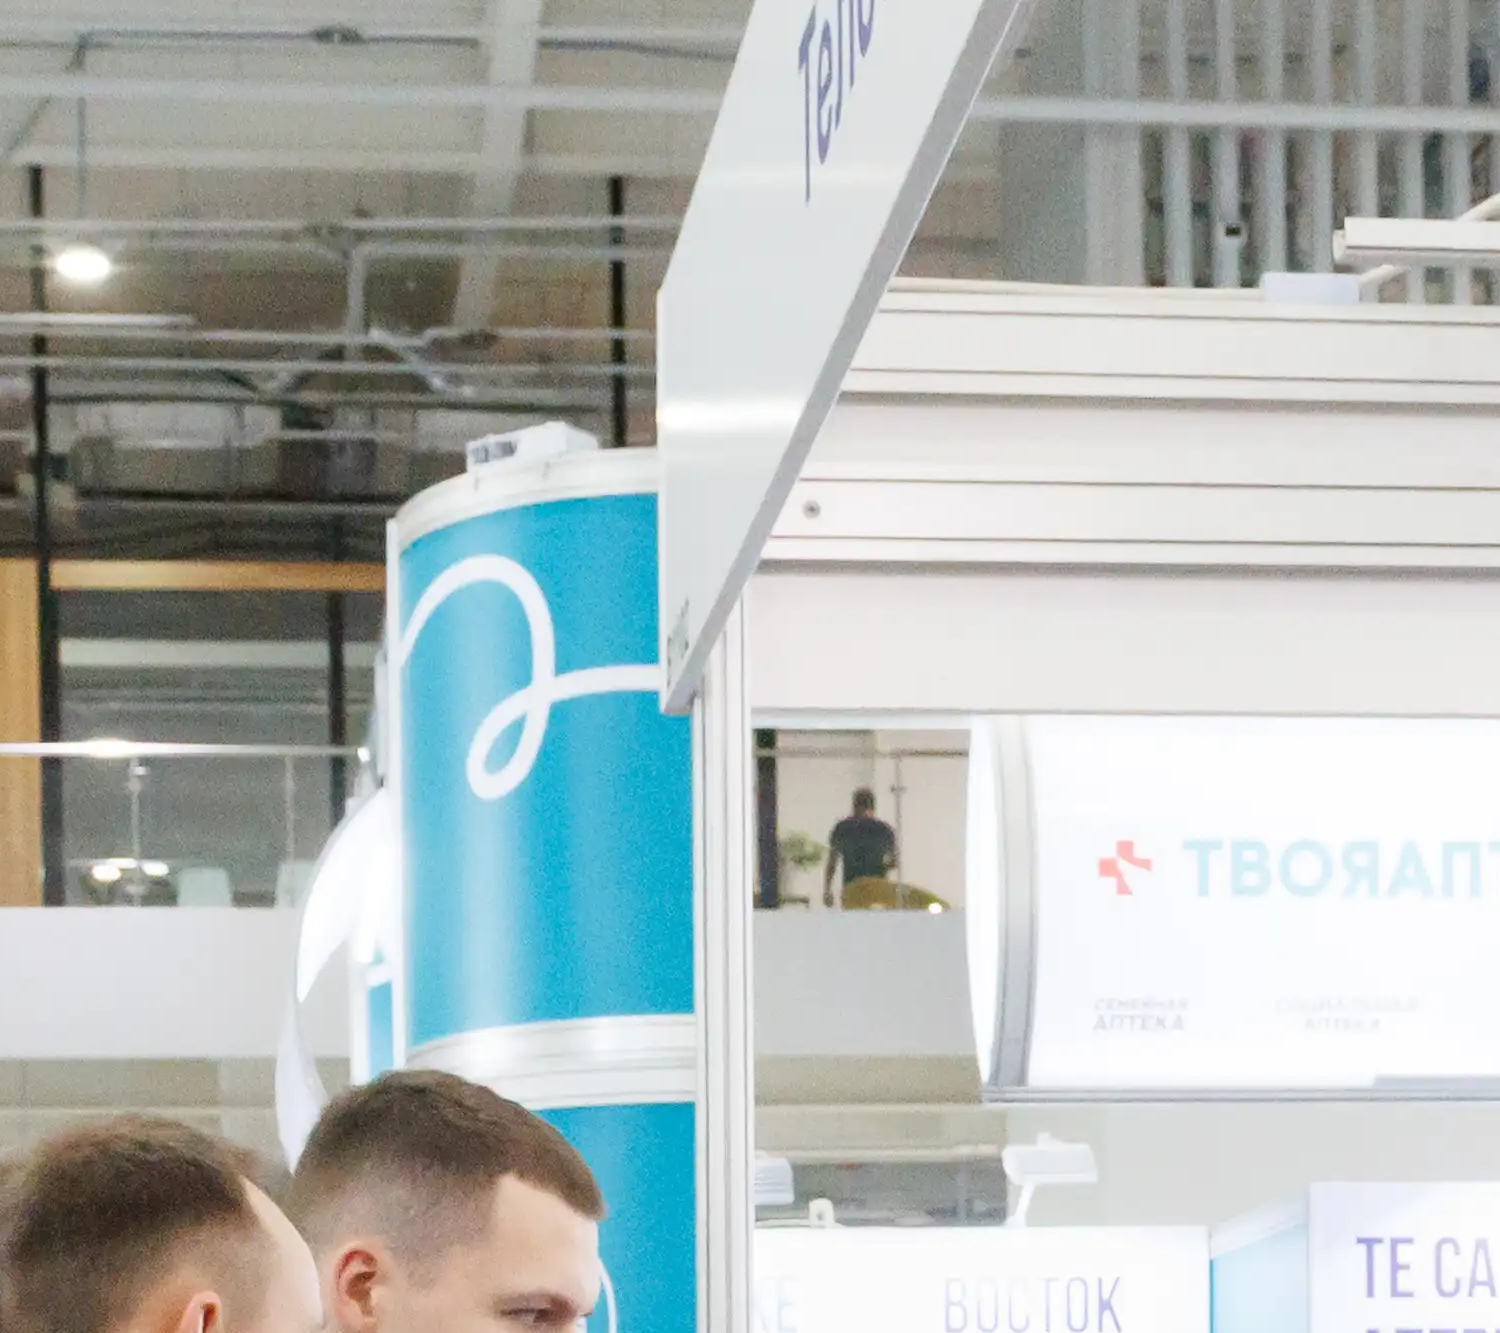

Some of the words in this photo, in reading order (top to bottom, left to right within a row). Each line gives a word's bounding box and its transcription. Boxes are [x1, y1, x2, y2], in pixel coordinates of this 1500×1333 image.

[1092, 1013, 1186, 1032] АПТЕКА
[1356, 1236, 1415, 1299] ТЕ
[944, 1276, 1122, 1333] ВОСТОК
